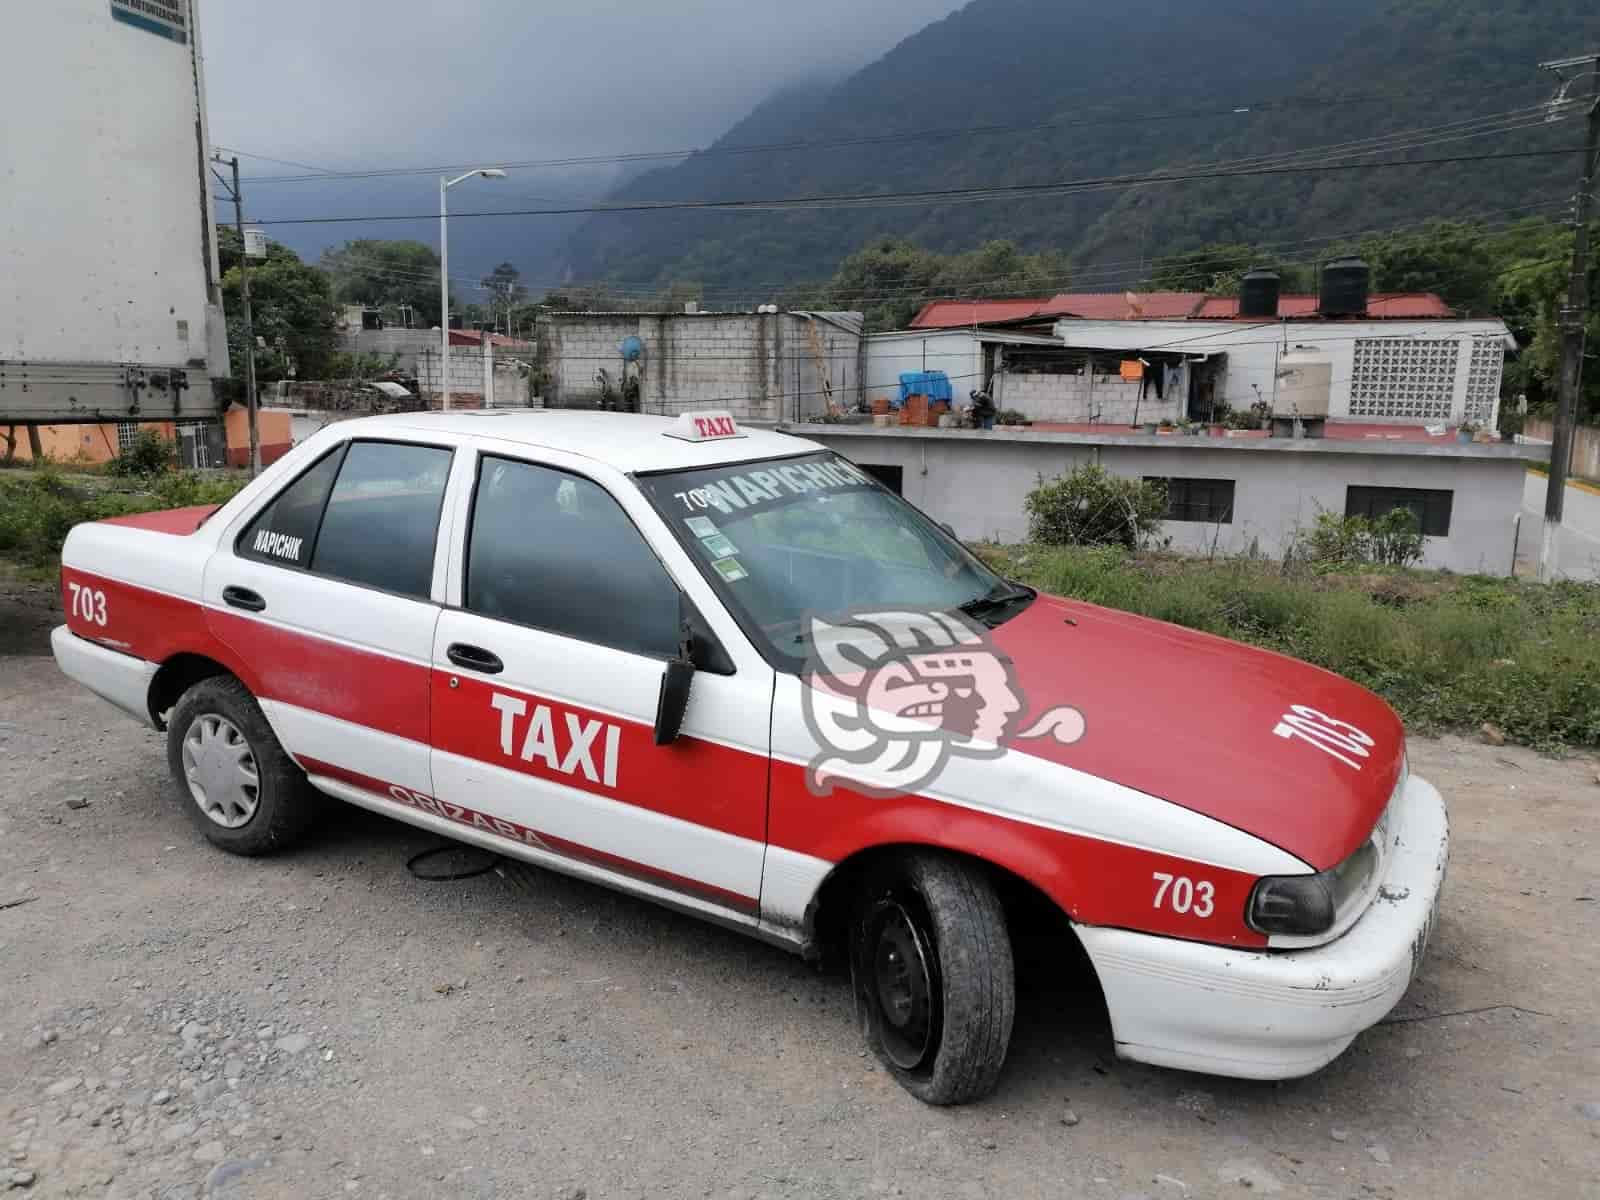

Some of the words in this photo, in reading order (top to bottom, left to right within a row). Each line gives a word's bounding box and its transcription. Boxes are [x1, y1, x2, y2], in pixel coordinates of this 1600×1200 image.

[694, 416, 736, 437] TAXI
[253, 529, 303, 561] NAPICHIK
[68, 582, 107, 626] 703
[491, 692, 622, 788] TAXI
[1272, 704, 1376, 771] 703
[388, 786, 553, 851] ORIZABA
[1152, 871, 1215, 918] 703
